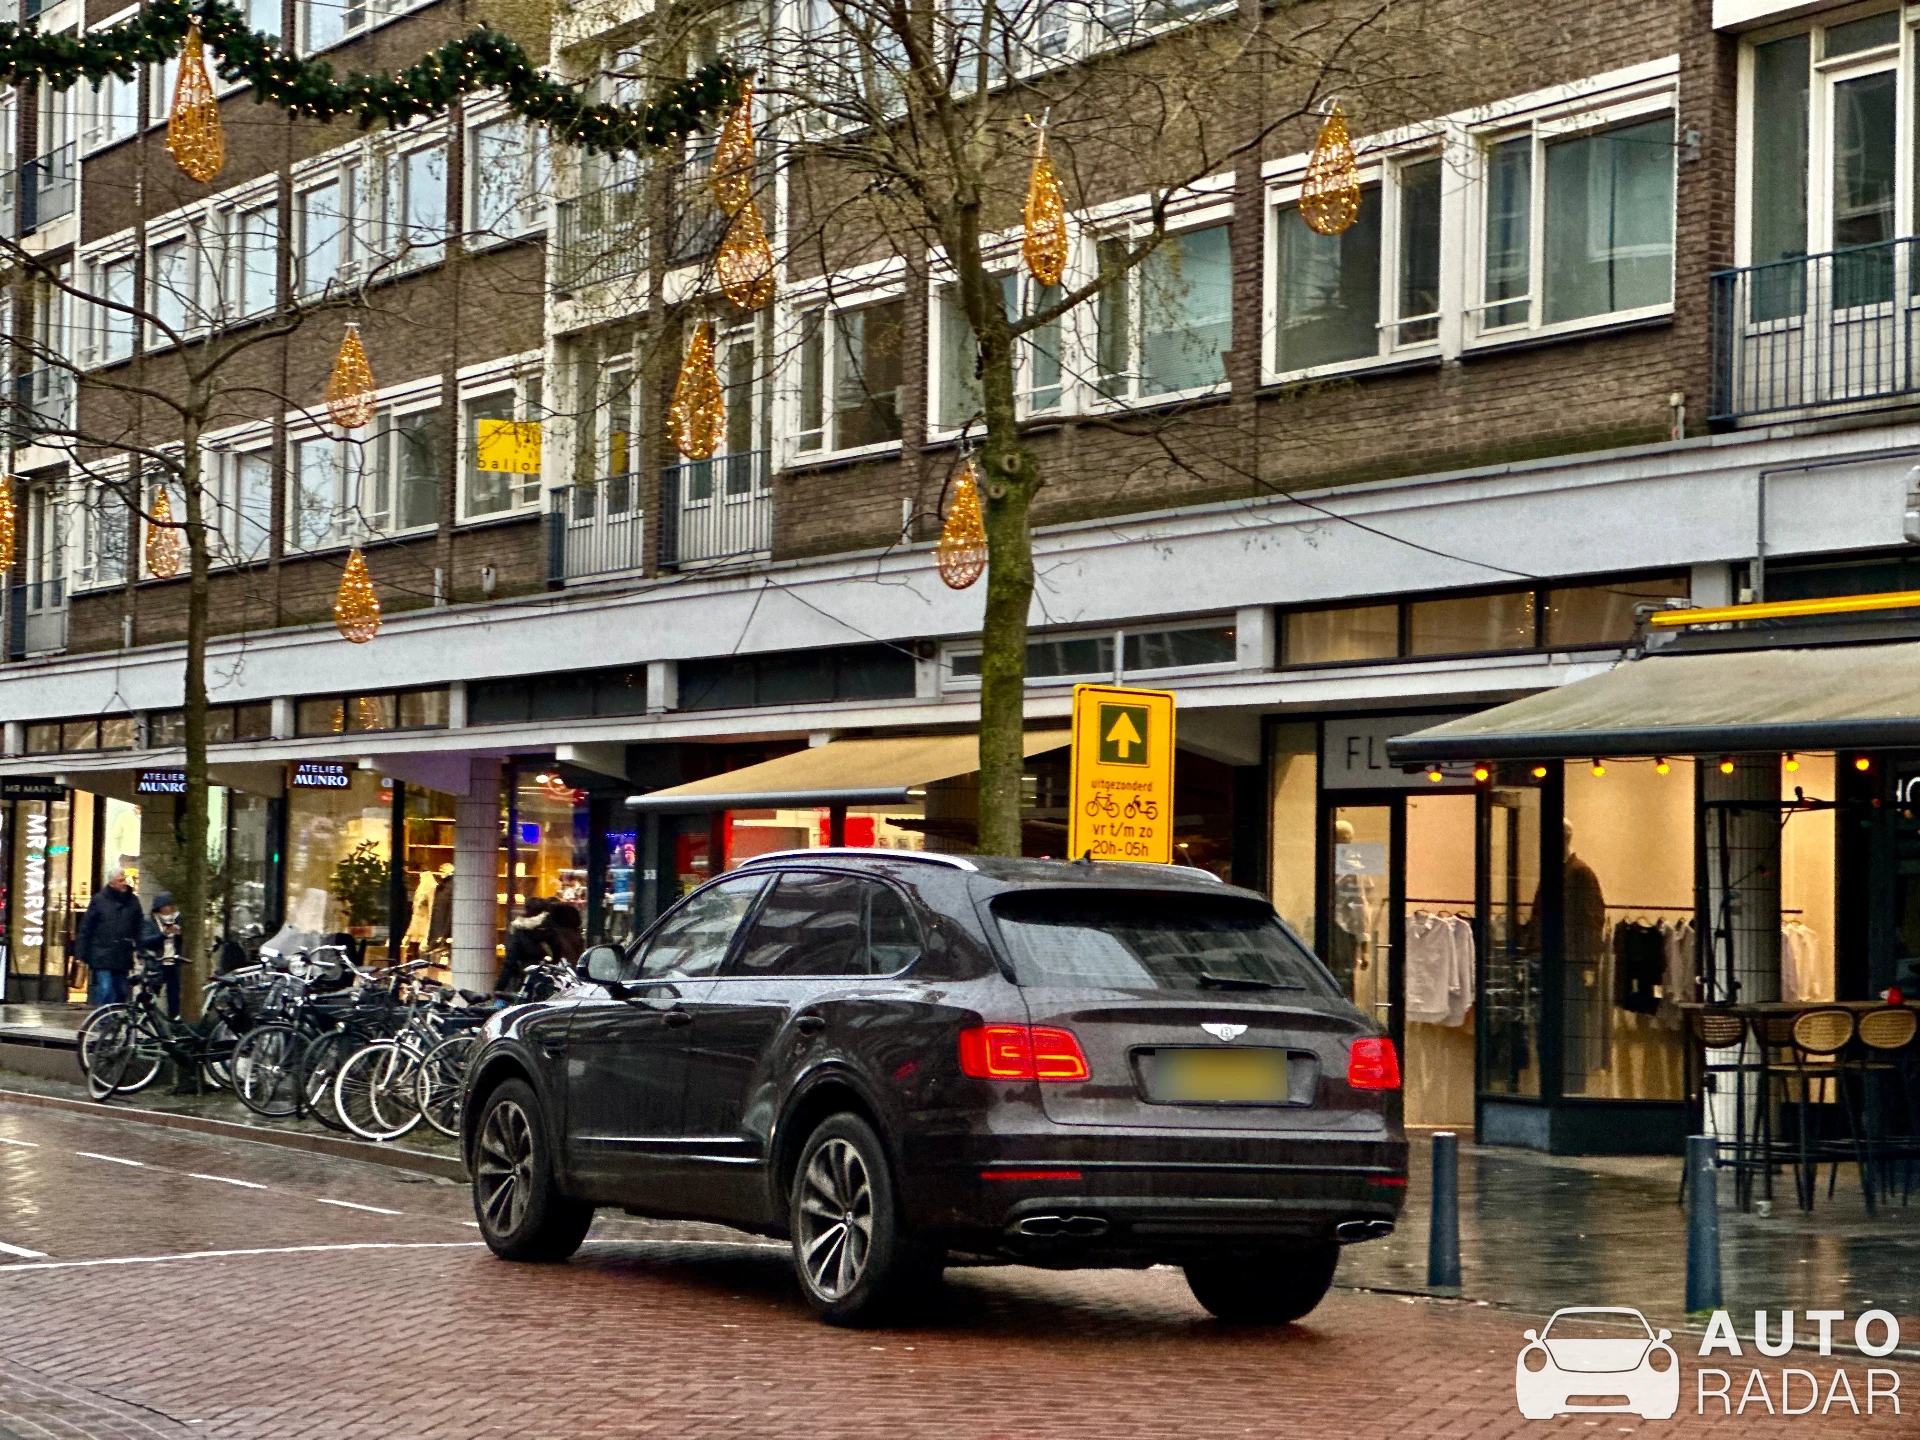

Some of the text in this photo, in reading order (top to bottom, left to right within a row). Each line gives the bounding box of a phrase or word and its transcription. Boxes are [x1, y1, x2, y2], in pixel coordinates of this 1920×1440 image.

[298, 764, 344, 774] ATELIER
[142, 772, 186, 781] ATELIER
[293, 775, 348, 786] MUNRO
[5, 784, 63, 794] MR MARVIS
[1091, 779, 1153, 792] uitgezonderd
[1093, 822, 1153, 838] vr t/m zo
[22, 814, 47, 947] MR MARVIS
